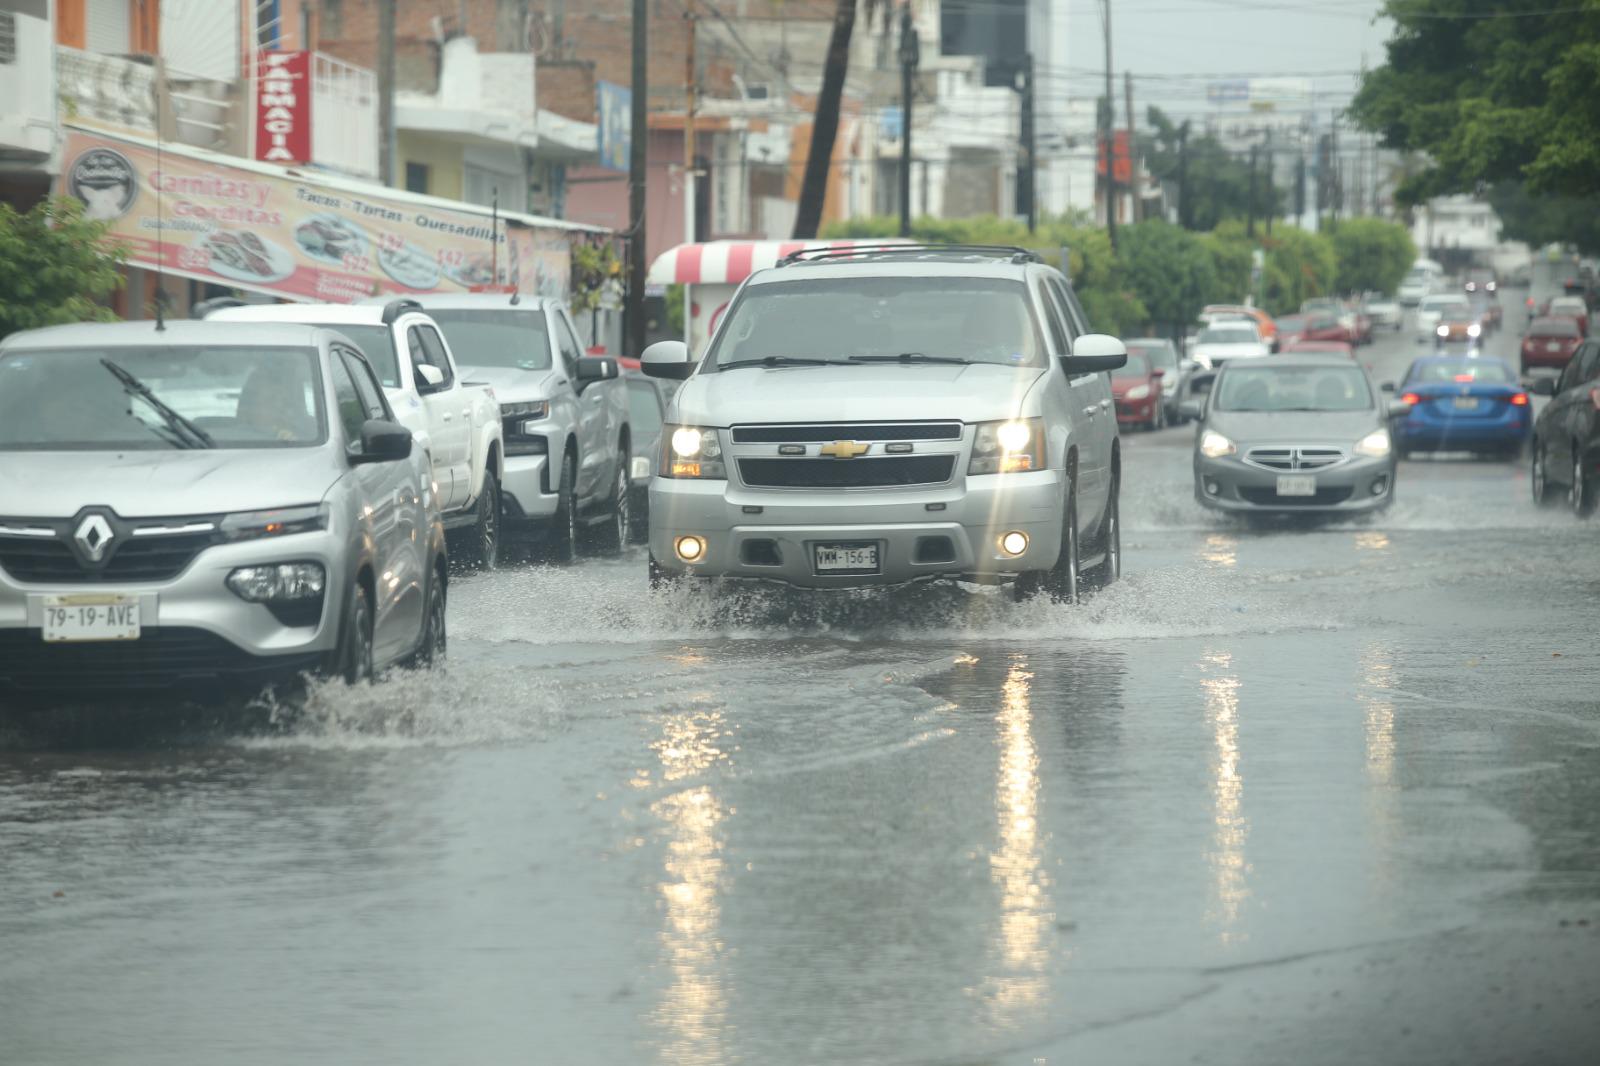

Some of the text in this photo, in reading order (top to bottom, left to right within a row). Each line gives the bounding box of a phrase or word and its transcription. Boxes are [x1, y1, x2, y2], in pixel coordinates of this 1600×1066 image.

[262, 54, 299, 160] FARMACIA
[148, 170, 250, 200] Carnitas
[174, 200, 282, 225] Gorditas
[415, 214, 506, 243] Quesadillas
[47, 606, 137, 627] 79-19-AVE
